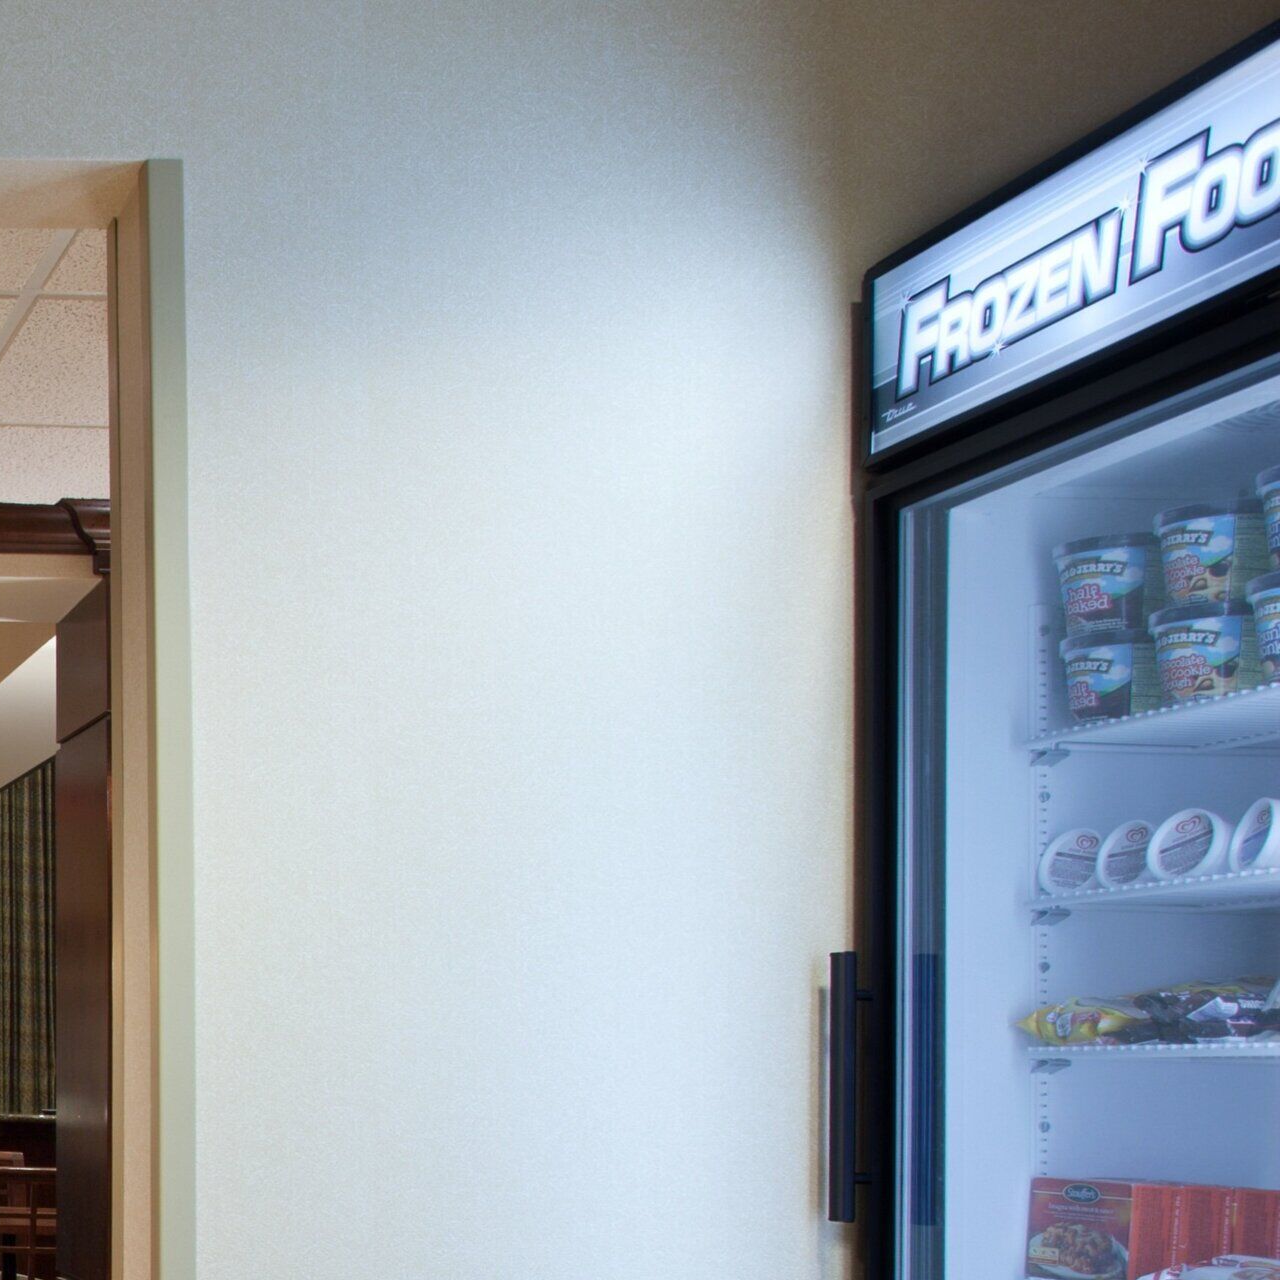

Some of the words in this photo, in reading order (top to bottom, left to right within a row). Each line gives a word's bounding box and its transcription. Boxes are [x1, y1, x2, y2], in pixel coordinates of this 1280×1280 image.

[896, 204, 1124, 402] FROZEN
[1069, 584, 1098, 602] half
[1066, 596, 1109, 615] baked
